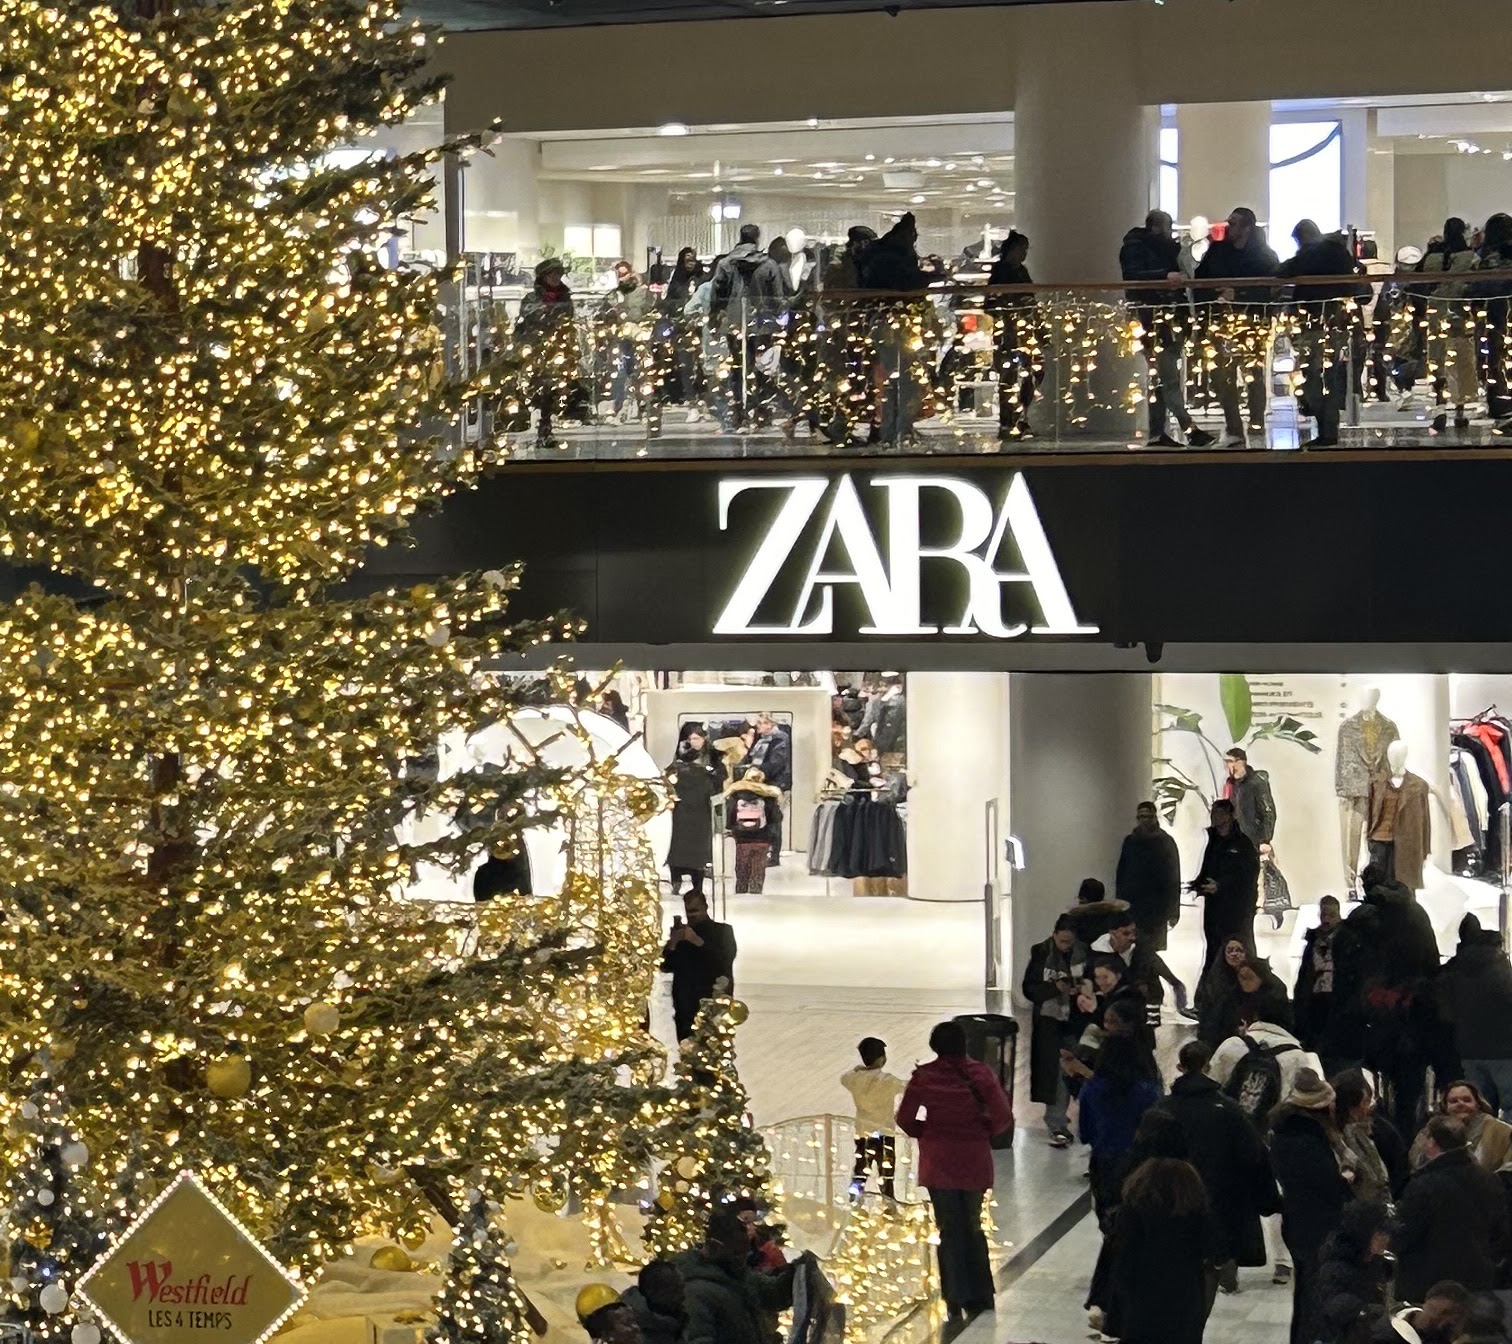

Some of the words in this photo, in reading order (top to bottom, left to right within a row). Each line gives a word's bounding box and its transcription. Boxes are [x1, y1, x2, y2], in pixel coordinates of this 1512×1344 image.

[712, 472, 1099, 638] ZARA
[126, 1261, 252, 1305] Westfield
[148, 1309, 171, 1328] LES
[188, 1310, 232, 1330] TEMPS
